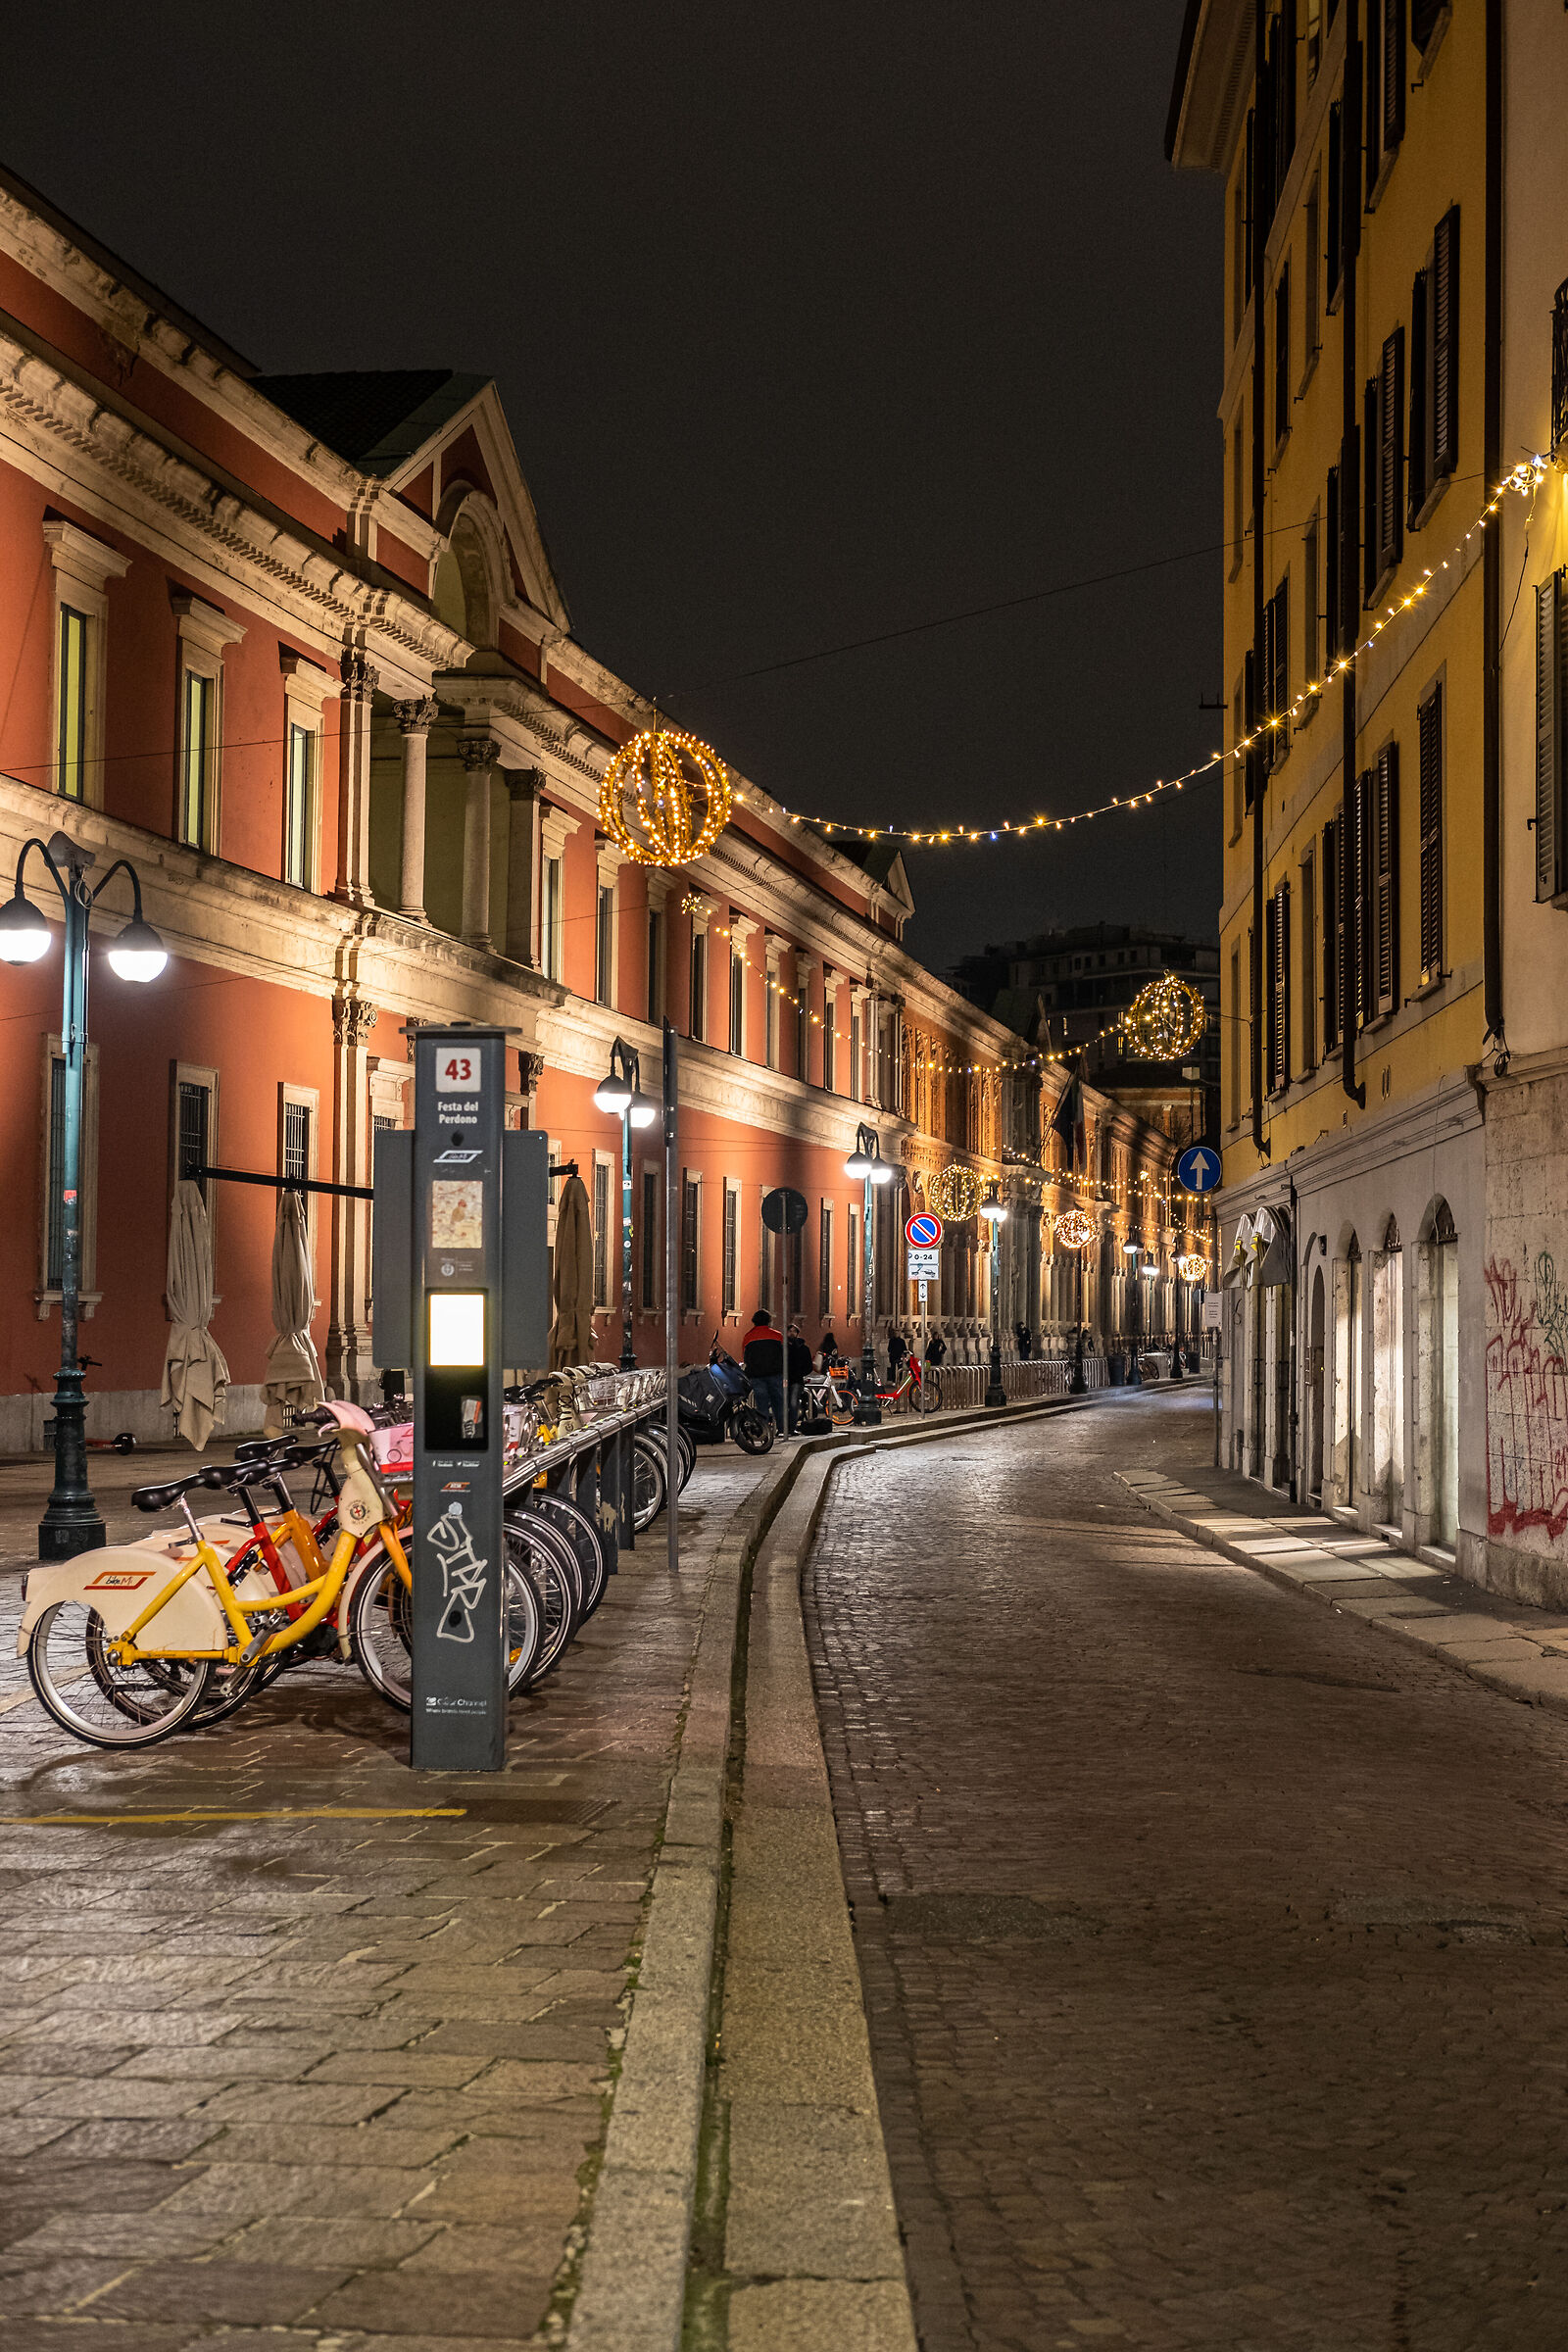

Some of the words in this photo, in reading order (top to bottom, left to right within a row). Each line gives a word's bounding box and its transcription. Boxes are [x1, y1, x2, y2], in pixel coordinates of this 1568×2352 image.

[445, 1058, 472, 1081] 43
[437, 1101, 463, 1112] Festa
[463, 1101, 479, 1112] del
[438, 1113, 478, 1124] Perdono
